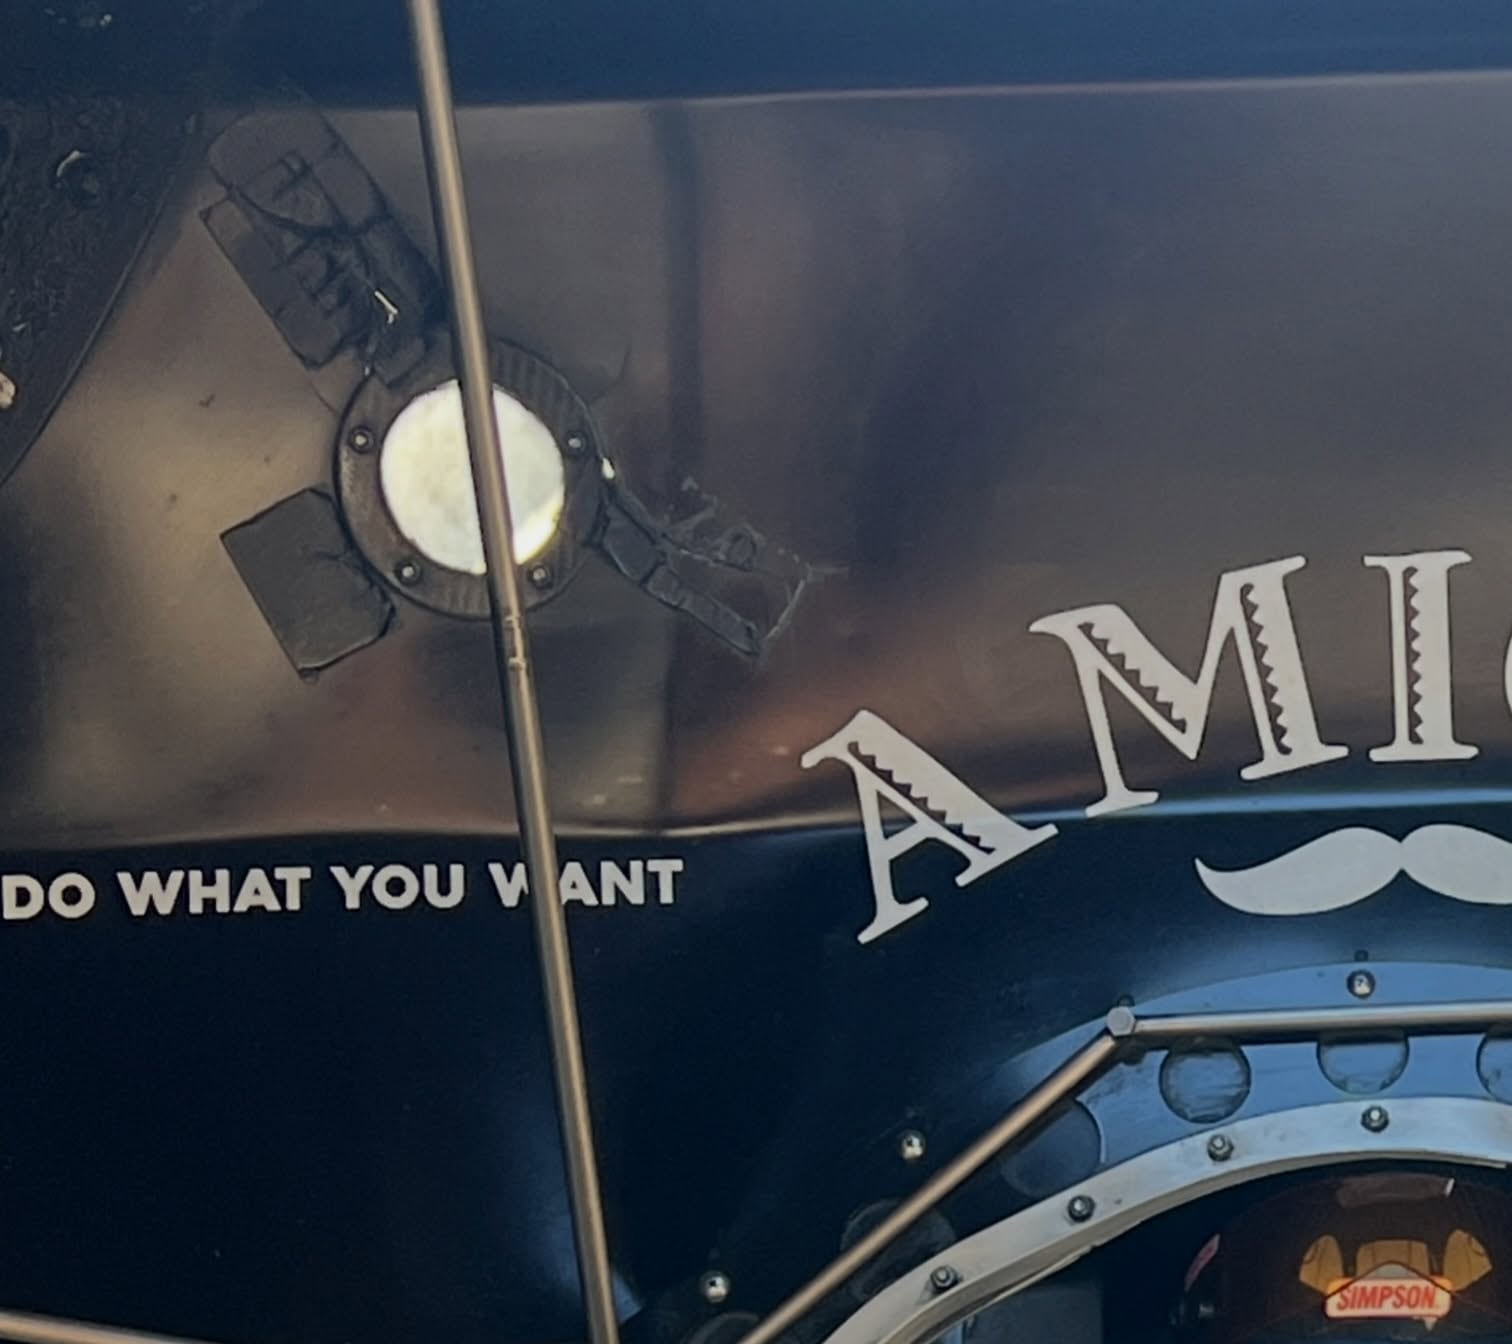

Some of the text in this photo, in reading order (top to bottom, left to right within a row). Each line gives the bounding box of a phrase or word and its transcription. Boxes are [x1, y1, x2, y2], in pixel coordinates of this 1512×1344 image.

[1, 859, 685, 921] DO WHAT YOU WANT
[1337, 1285, 1436, 1310] SIMPSON
